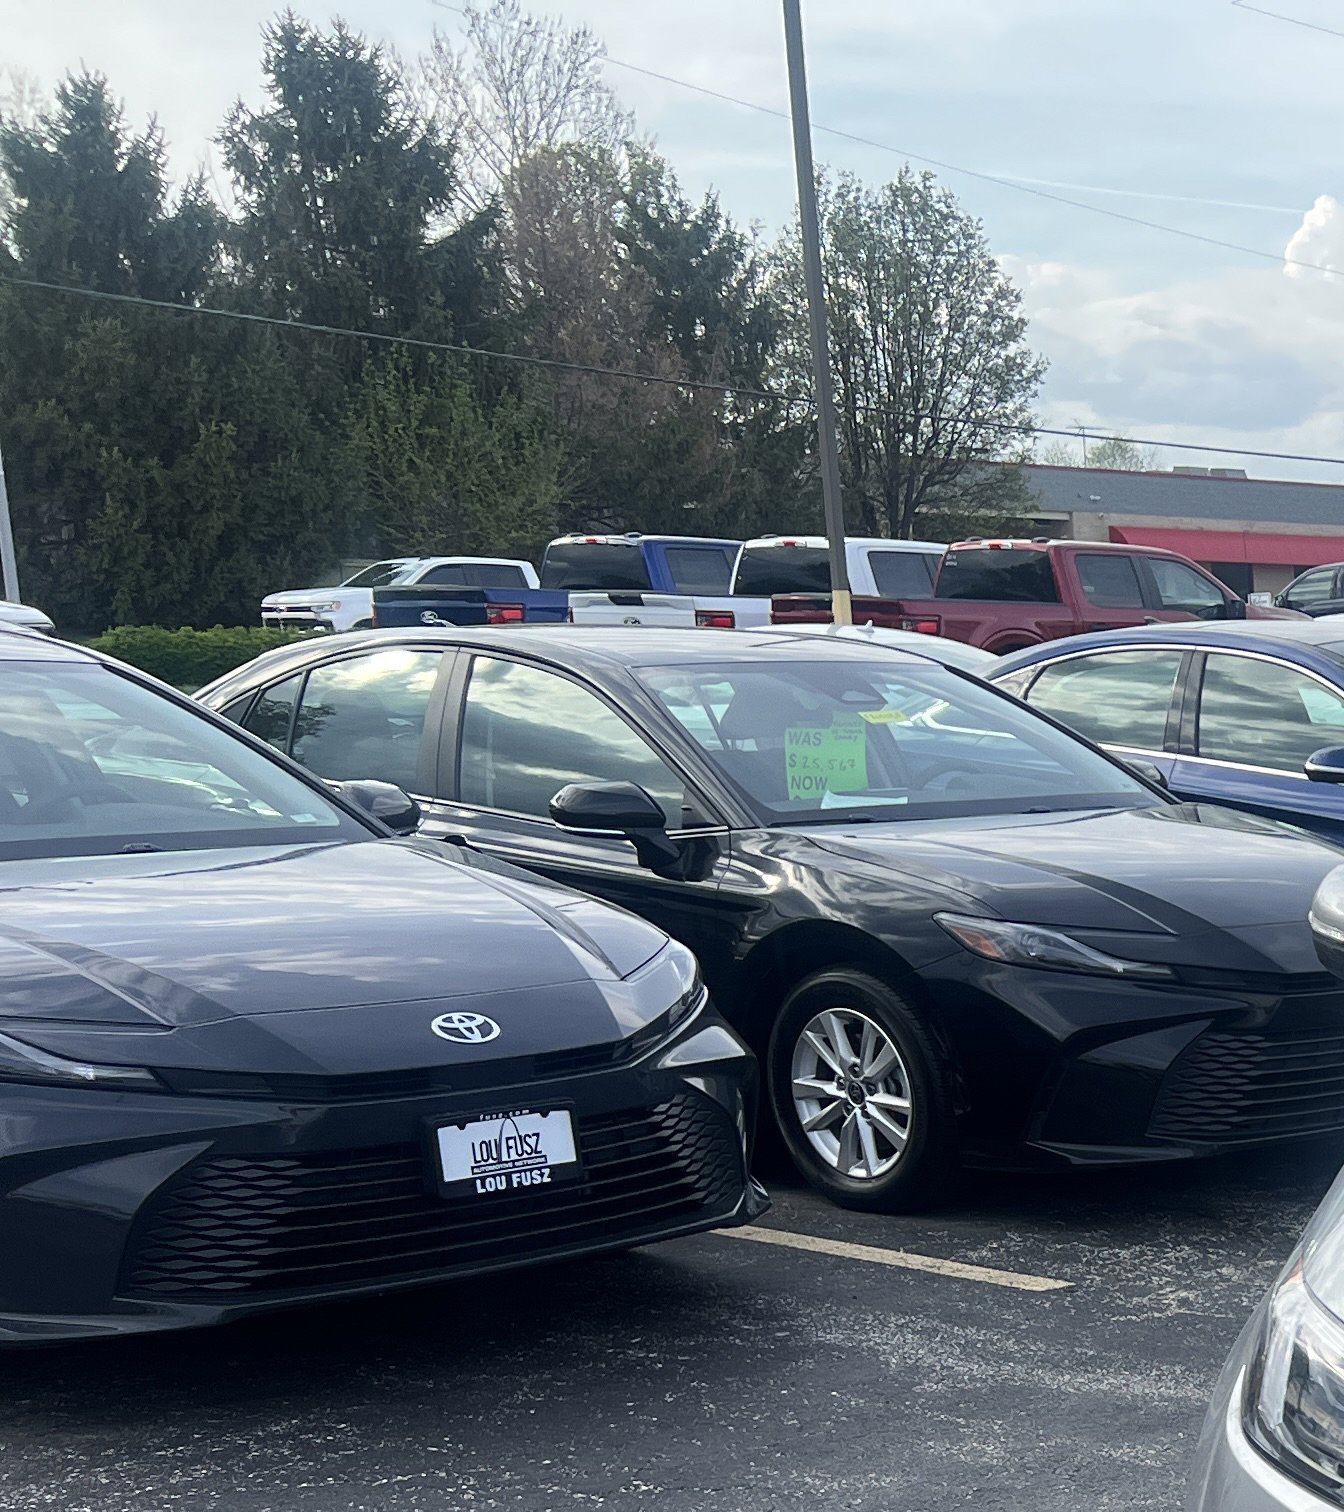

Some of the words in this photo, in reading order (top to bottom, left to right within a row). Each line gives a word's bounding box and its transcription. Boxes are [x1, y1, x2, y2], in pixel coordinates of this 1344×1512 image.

[787, 731, 822, 747] WAS
[790, 775, 829, 791] NOW
[471, 1138, 499, 1165] LOU
[505, 1132, 542, 1159] FUSZ
[476, 1175, 507, 1194] LOU
[511, 1168, 552, 1188] FUSZ
